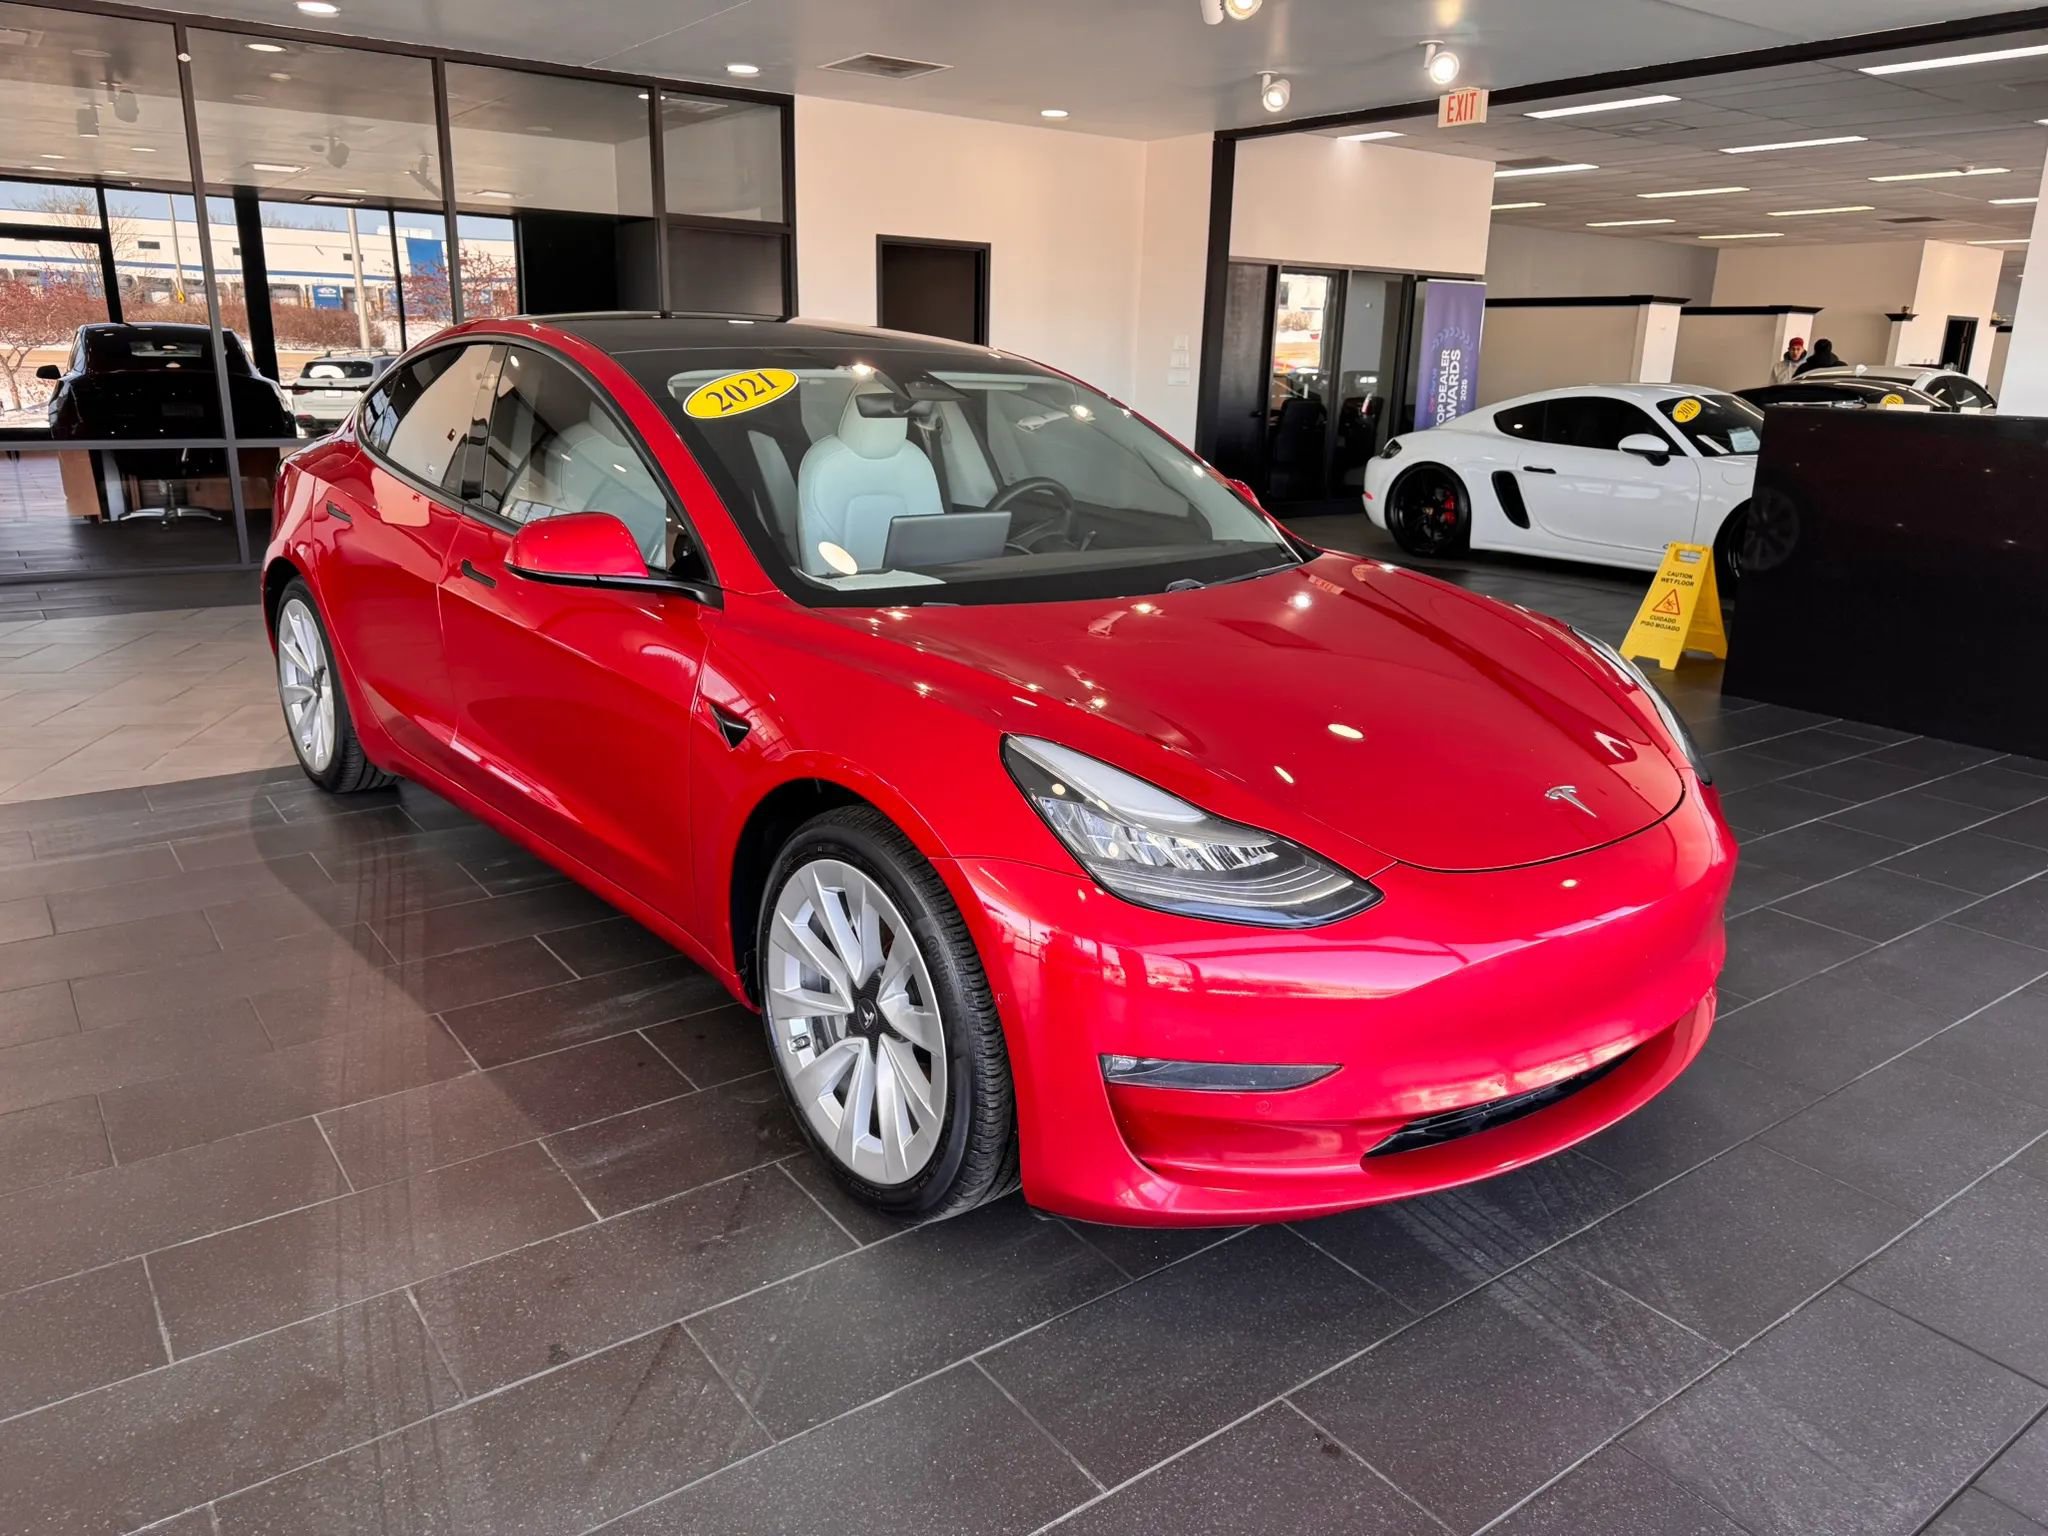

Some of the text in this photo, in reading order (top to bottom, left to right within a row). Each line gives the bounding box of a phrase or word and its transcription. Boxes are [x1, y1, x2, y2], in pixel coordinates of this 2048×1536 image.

[1446, 92, 1477, 123] EXIT
[706, 372, 779, 412] 2021
[1436, 349, 1450, 426] OP DEALER
[1667, 571, 1693, 580] CAUTION
[1674, 579, 1694, 587] FLOOR
[1650, 615, 1677, 623] CUIDADO
[1640, 620, 1680, 631] PISO MOJADO
